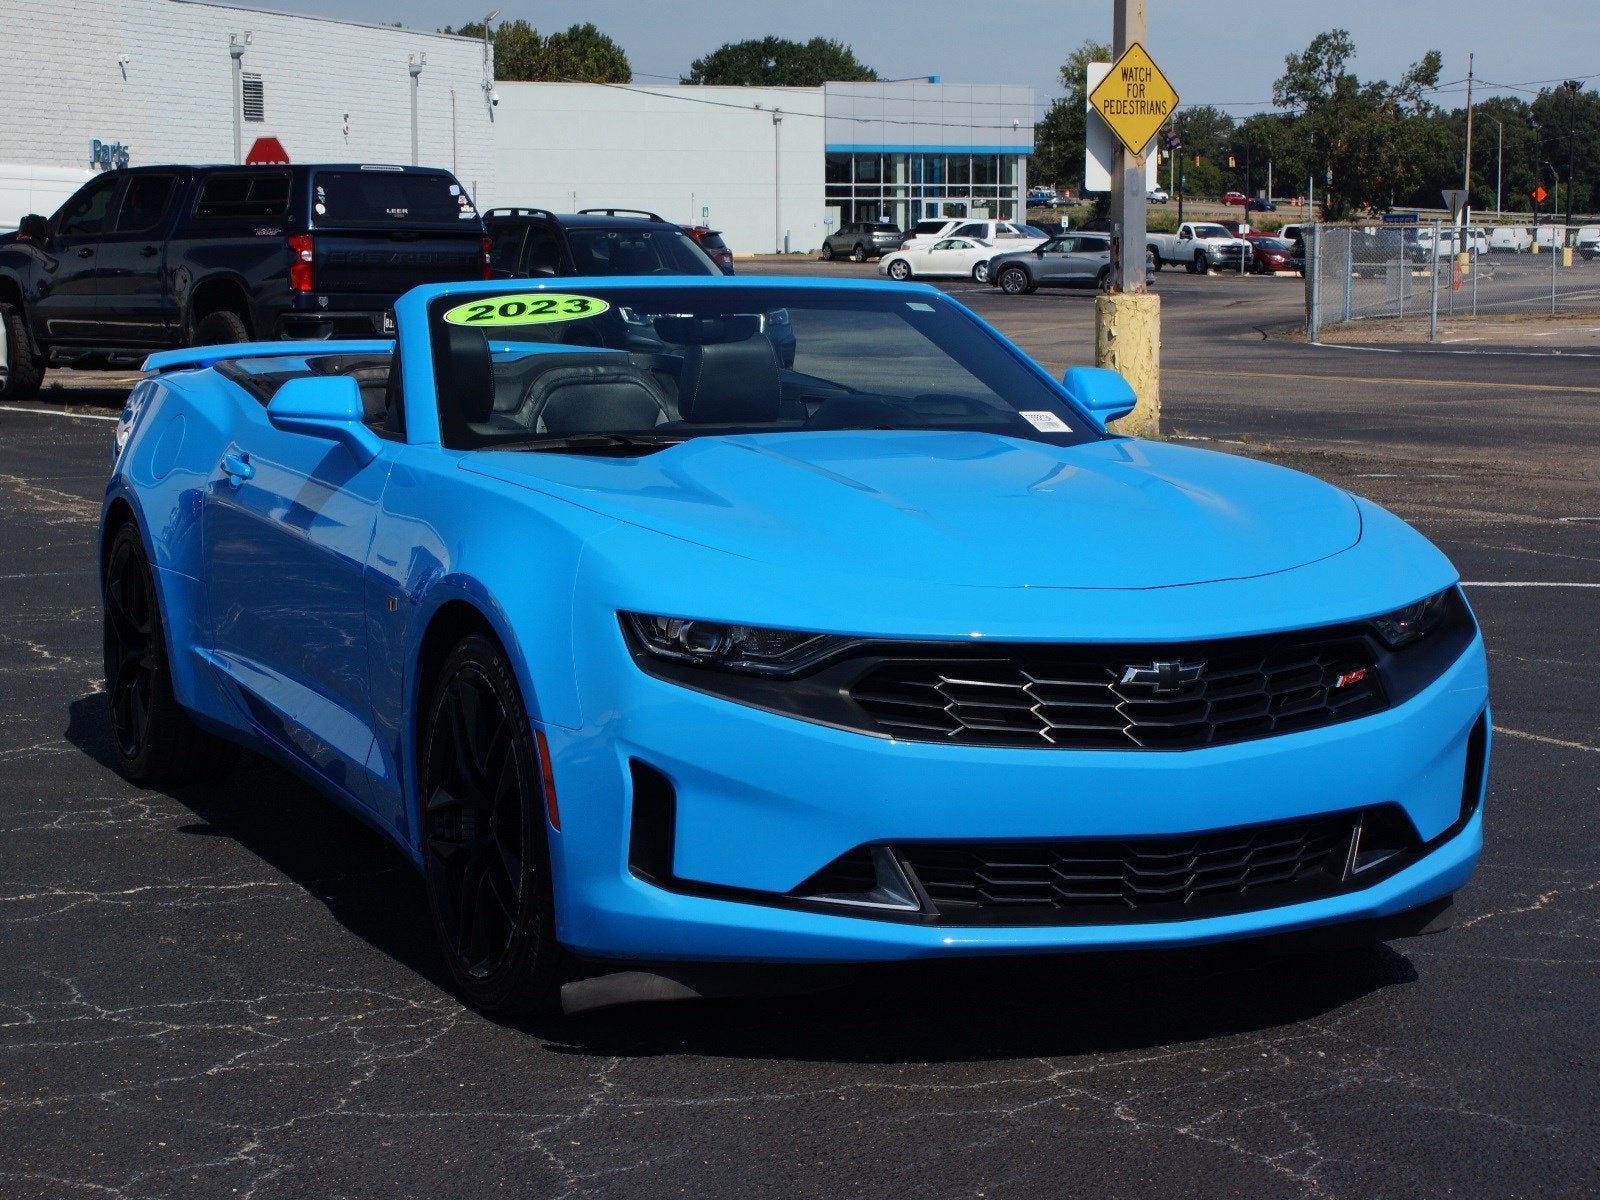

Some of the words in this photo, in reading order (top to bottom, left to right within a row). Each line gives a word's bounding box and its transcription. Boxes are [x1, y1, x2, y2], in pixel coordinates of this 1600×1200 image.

[1121, 67, 1152, 82] WATCH
[1126, 83, 1146, 98] FOR
[1103, 99, 1167, 115] PEDESTRIANS
[90, 138, 130, 163] Parts
[465, 298, 592, 322] 2023
